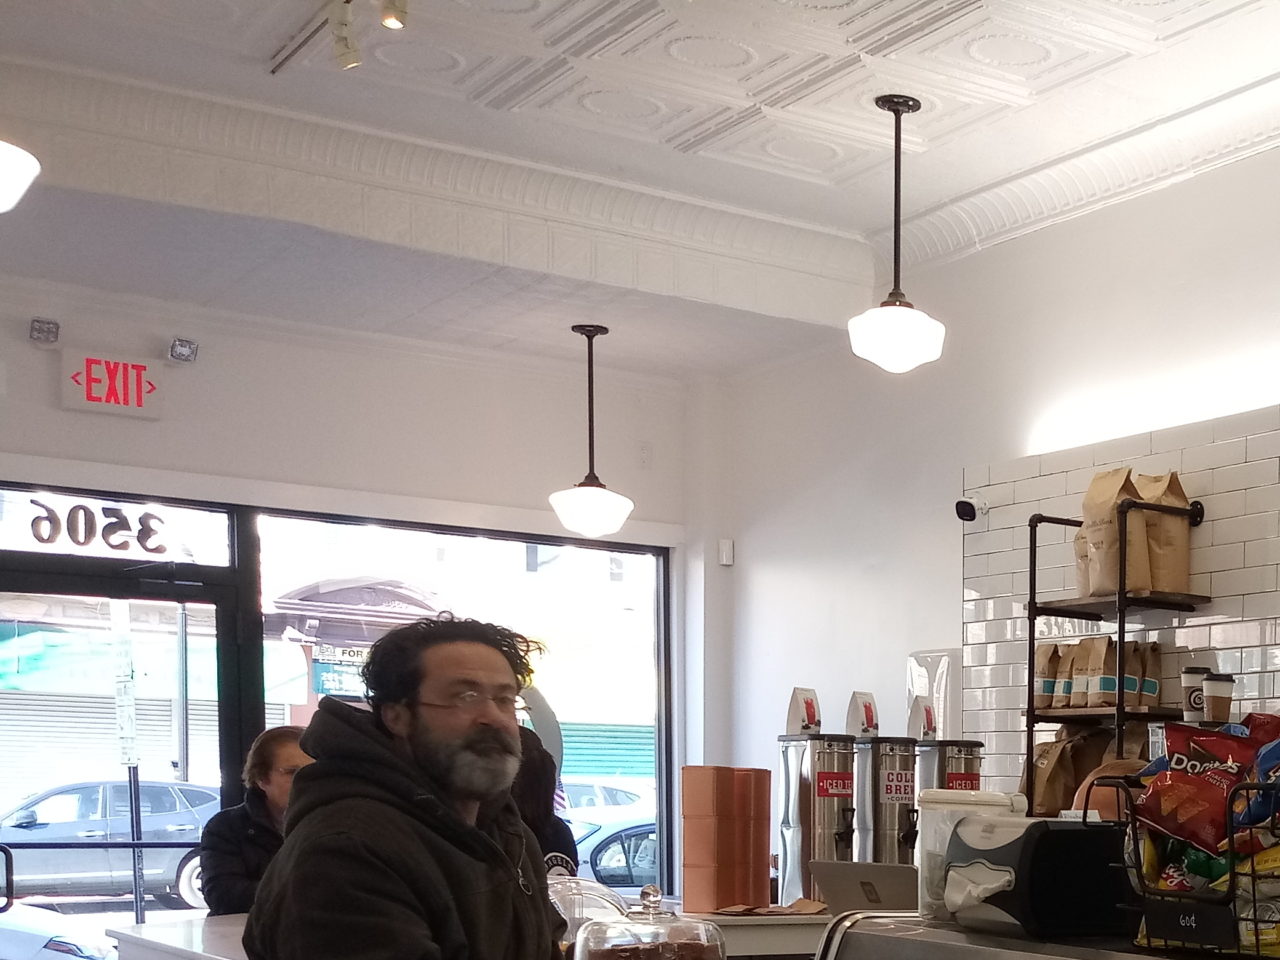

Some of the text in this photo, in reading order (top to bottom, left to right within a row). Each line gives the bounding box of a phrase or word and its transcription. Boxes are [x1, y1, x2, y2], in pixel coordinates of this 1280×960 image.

[85, 358, 147, 407] EXIT
[342, 649, 363, 658] FOR
[1170, 753, 1242, 774] Doritos
[824, 779, 843, 789] ICED
[953, 780, 971, 789] ICED
